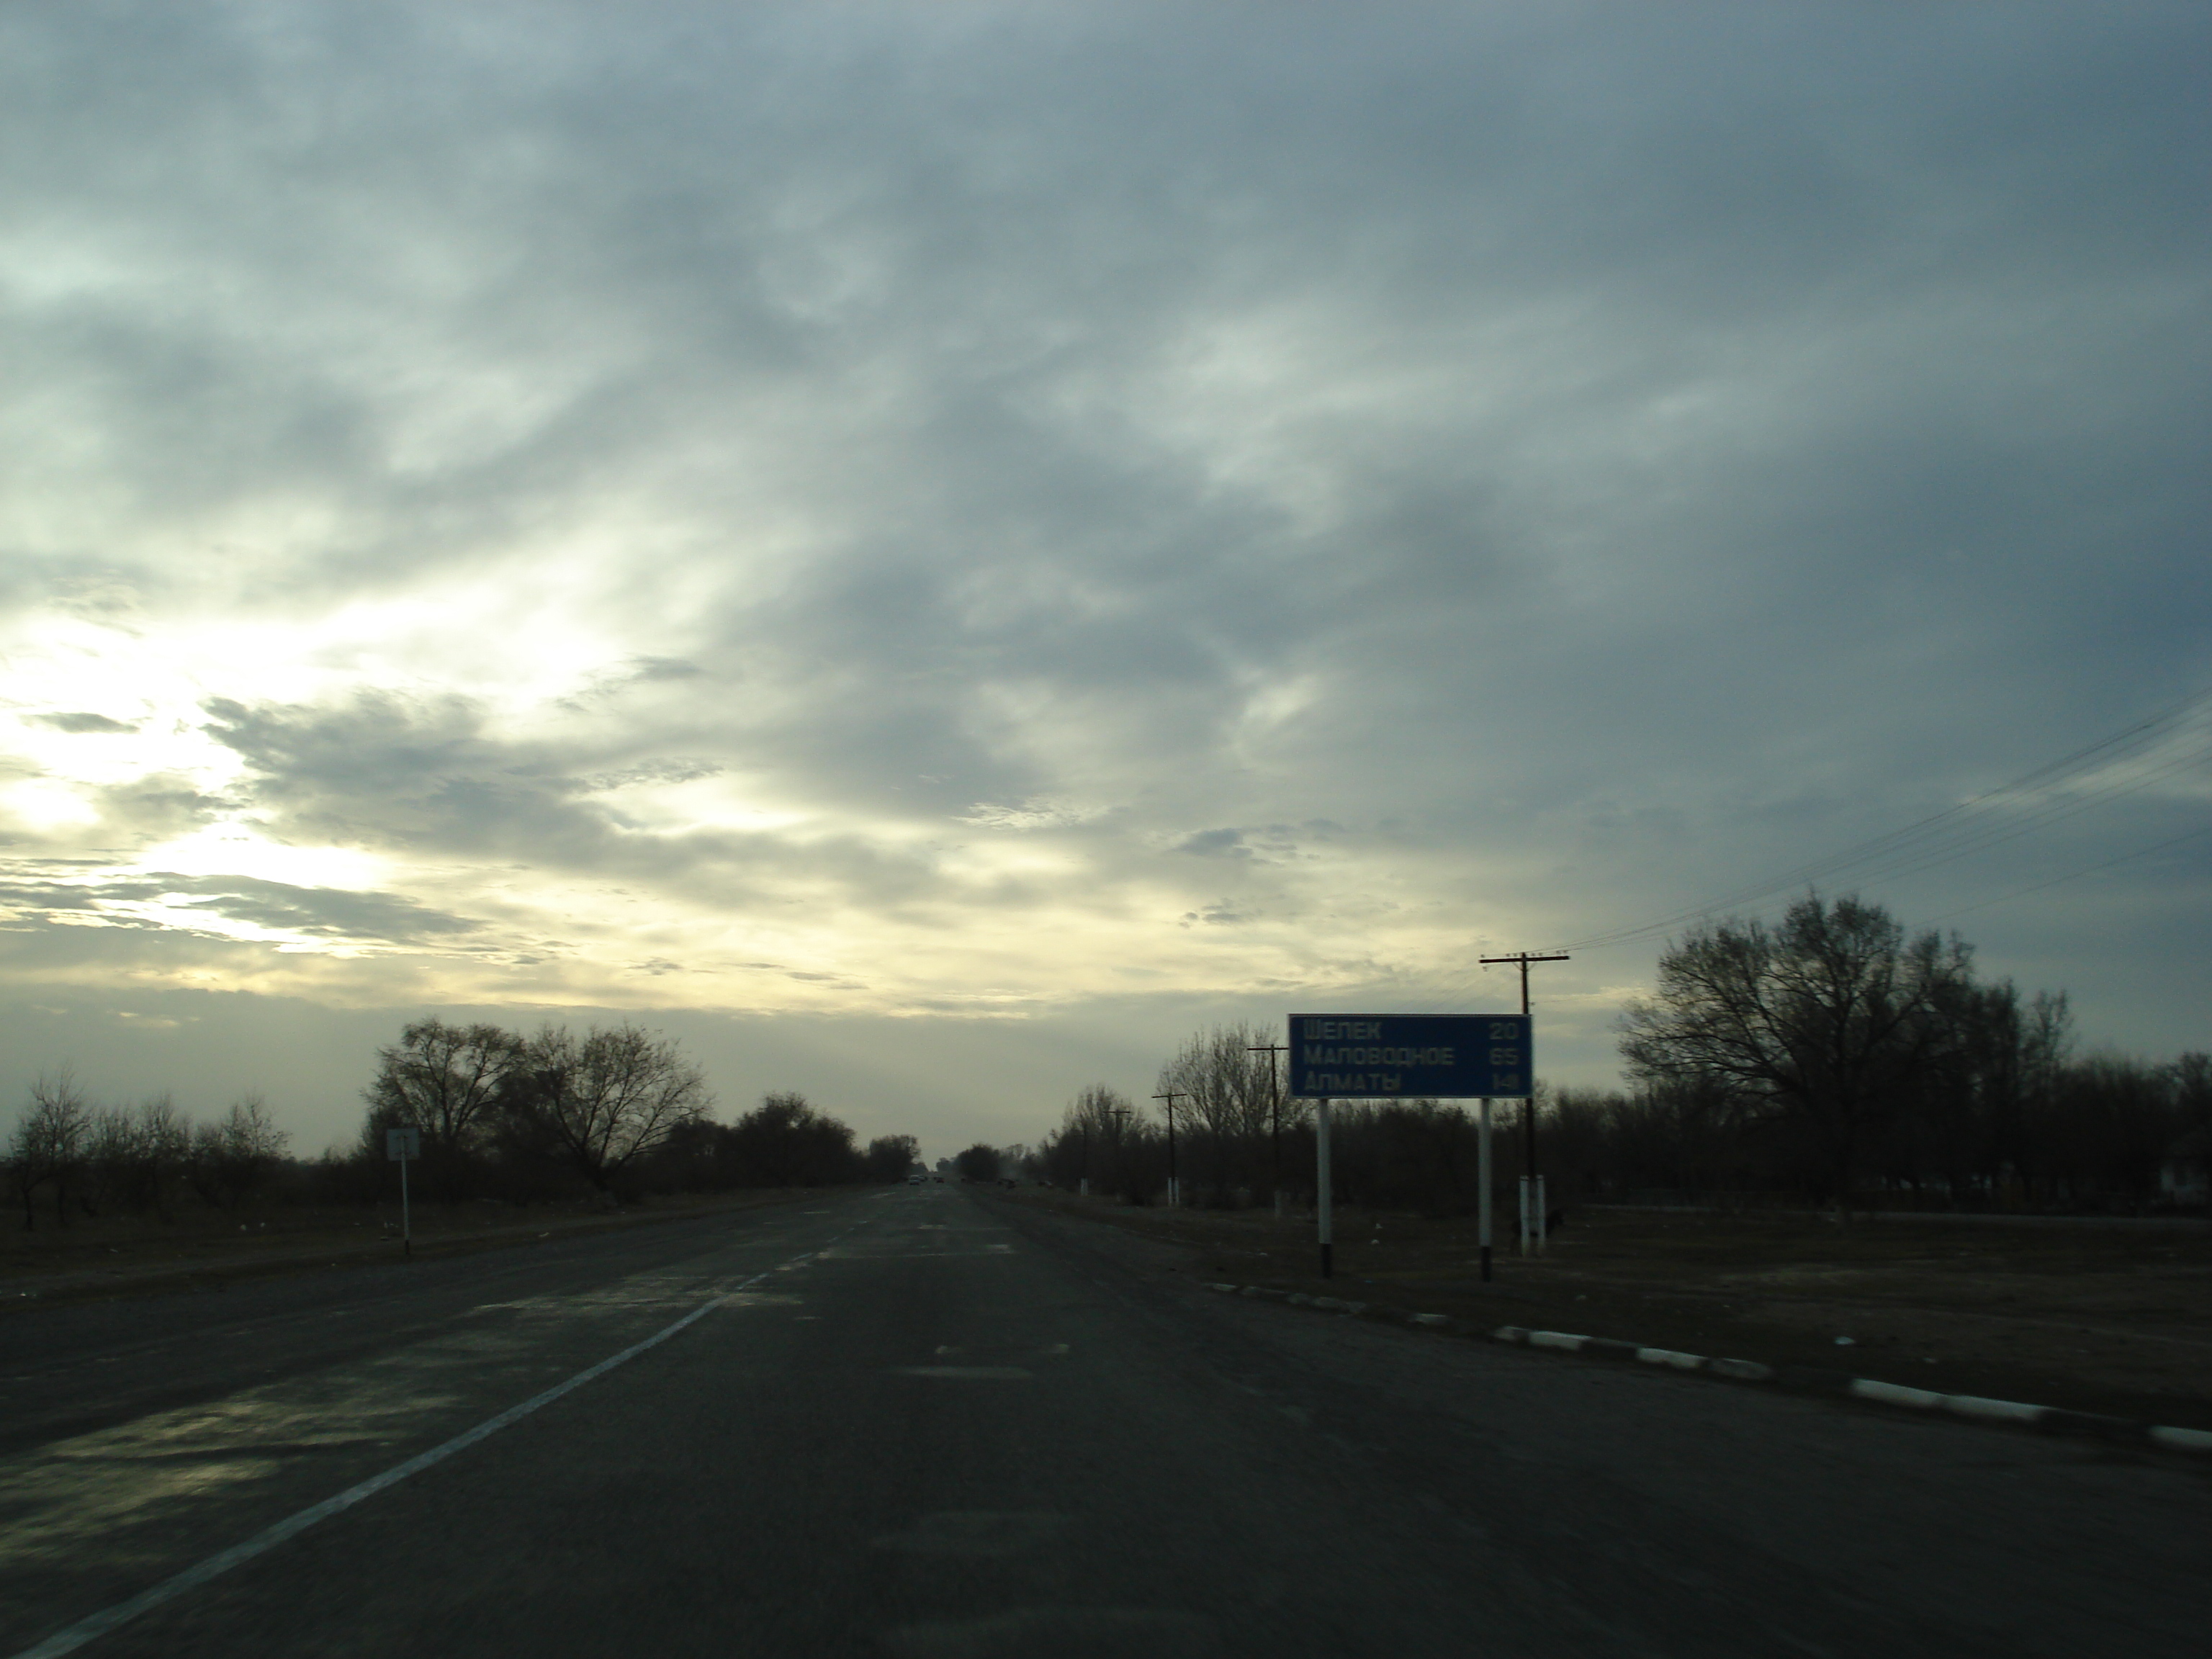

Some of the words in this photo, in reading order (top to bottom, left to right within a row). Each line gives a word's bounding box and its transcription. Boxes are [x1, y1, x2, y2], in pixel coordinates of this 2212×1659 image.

[1488, 1022, 1519, 1040] 20
[1489, 1047, 1519, 1066] 65
[1303, 1071, 1402, 1091] АЛМАТЫ
